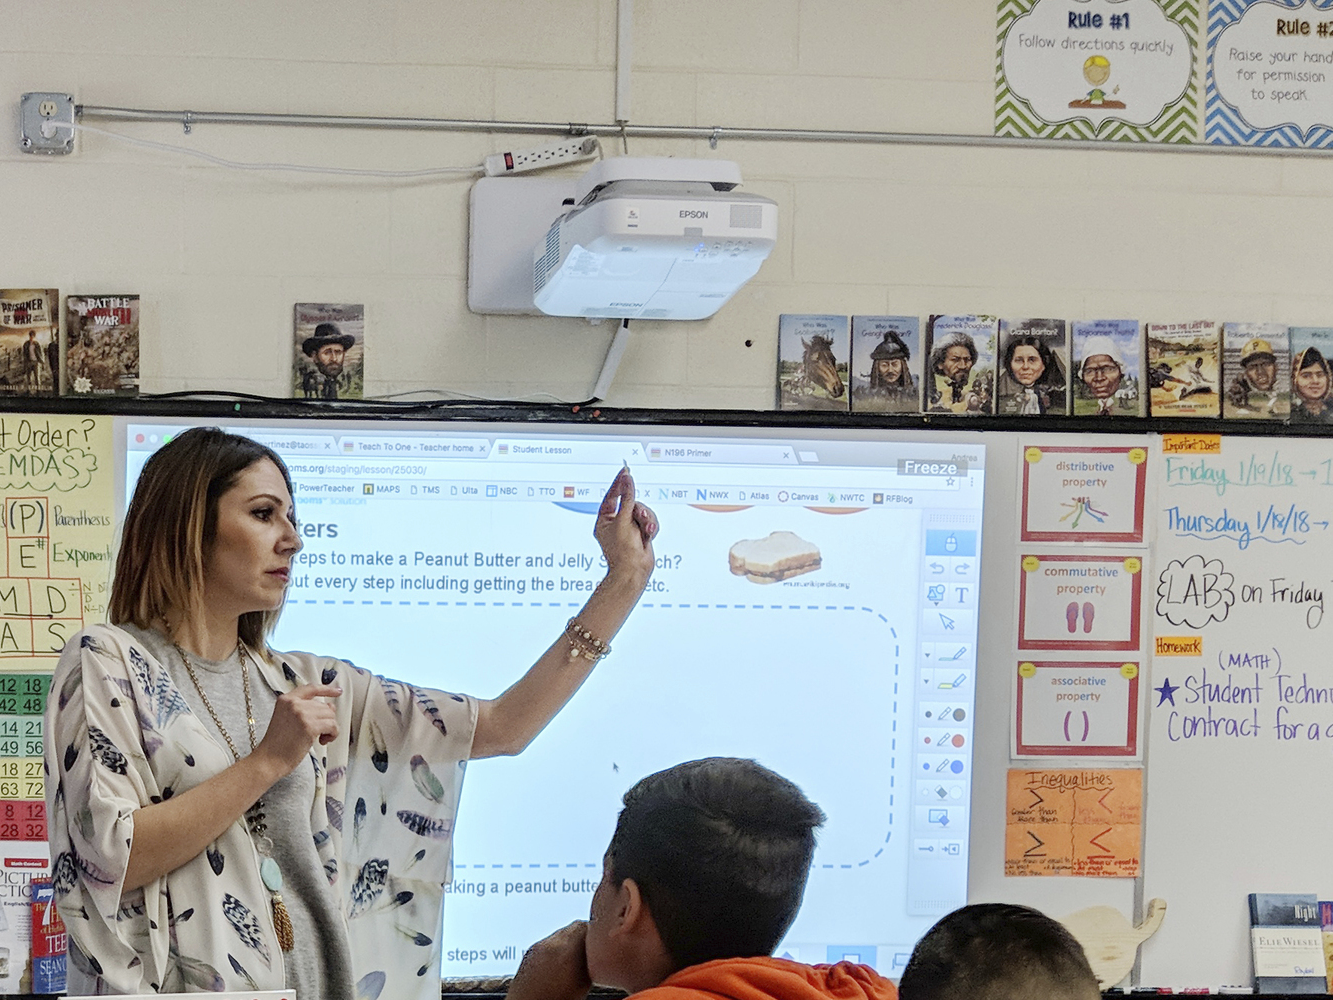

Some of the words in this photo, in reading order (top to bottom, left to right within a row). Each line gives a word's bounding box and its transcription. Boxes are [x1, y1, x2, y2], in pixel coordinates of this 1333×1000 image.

[1068, 11, 1103, 29] Rule
[1109, 12, 1130, 29] #1
[1276, 18, 1310, 36] Rule
[1019, 34, 1056, 48] Follow
[1061, 36, 1125, 50] directions
[1130, 40, 1174, 55] quickly
[1229, 47, 1263, 61] Raise
[1269, 52, 1297, 65] your
[1304, 51, 1333, 64] hand
[1236, 69, 1256, 80] for
[1263, 71, 1325, 84] permission
[1251, 88, 1265, 100] to
[679, 210, 709, 220] EPSON
[1, 298, 43, 313] PRISONER
[87, 298, 130, 309] BATTLE
[94, 315, 119, 326] WAR
[18, 419, 96, 451] Order?
[358, 442, 381, 451] Teach
[395, 443, 411, 451] One
[420, 443, 450, 452] Teacher
[452, 444, 474, 453] home
[512, 445, 542, 454] Student
[544, 446, 572, 455] Lesson
[687, 449, 712, 458] Primer
[904, 460, 958, 475] Freeze
[1056, 461, 1115, 471] distributive
[1062, 478, 1107, 488] property
[1166, 456, 1230, 496] Friday
[299, 483, 355, 493] PowerTeacher
[377, 485, 401, 494] MAPS
[422, 486, 440, 494] TMS
[500, 487, 518, 495] NBC
[539, 488, 556, 496] TTO
[709, 491, 729, 499] NWX
[750, 492, 770, 500] Atlas
[791, 492, 819, 501] Canvas
[840, 493, 865, 502] NWTC
[886, 494, 914, 504] RFBlog
[54, 504, 111, 527] Parenthesis
[1163, 505, 1251, 550] Thursday
[331, 551, 346, 566] to
[351, 551, 394, 566] make
[399, 554, 407, 566] a
[414, 551, 468, 567] Peanut
[474, 552, 521, 567] Butter
[525, 553, 554, 568] and
[559, 553, 593, 571] Jelly
[1044, 567, 1119, 577] commutative
[315, 577, 358, 593] every
[363, 575, 395, 593] step
[400, 575, 468, 593] including
[473, 576, 526, 594] getting
[531, 577, 555, 591] the
[1057, 584, 1106, 595] property
[1167, 573, 1223, 609] LAB
[1242, 585, 1262, 603] on
[1270, 578, 1324, 629] Friday
[1156, 638, 1201, 653] Homework
[1219, 647, 1281, 675] (MATH)
[1051, 677, 1107, 686] associative
[1185, 668, 1264, 704] Student
[1056, 692, 1101, 702] property
[1168, 706, 1261, 741] Contract
[1273, 706, 1304, 740] for
[1308, 723, 1319, 740] a
[0, 741, 19, 755] 49
[25, 741, 44, 755] 56
[25, 762, 44, 777] 27
[0, 782, 19, 797] 63
[25, 782, 44, 797] 72
[1025, 771, 1114, 793] Inequalities
[505, 879, 557, 896] peanut
[562, 878, 599, 893] butte
[1294, 905, 1316, 922] Night
[447, 948, 487, 964] steps
[493, 946, 516, 960] will
